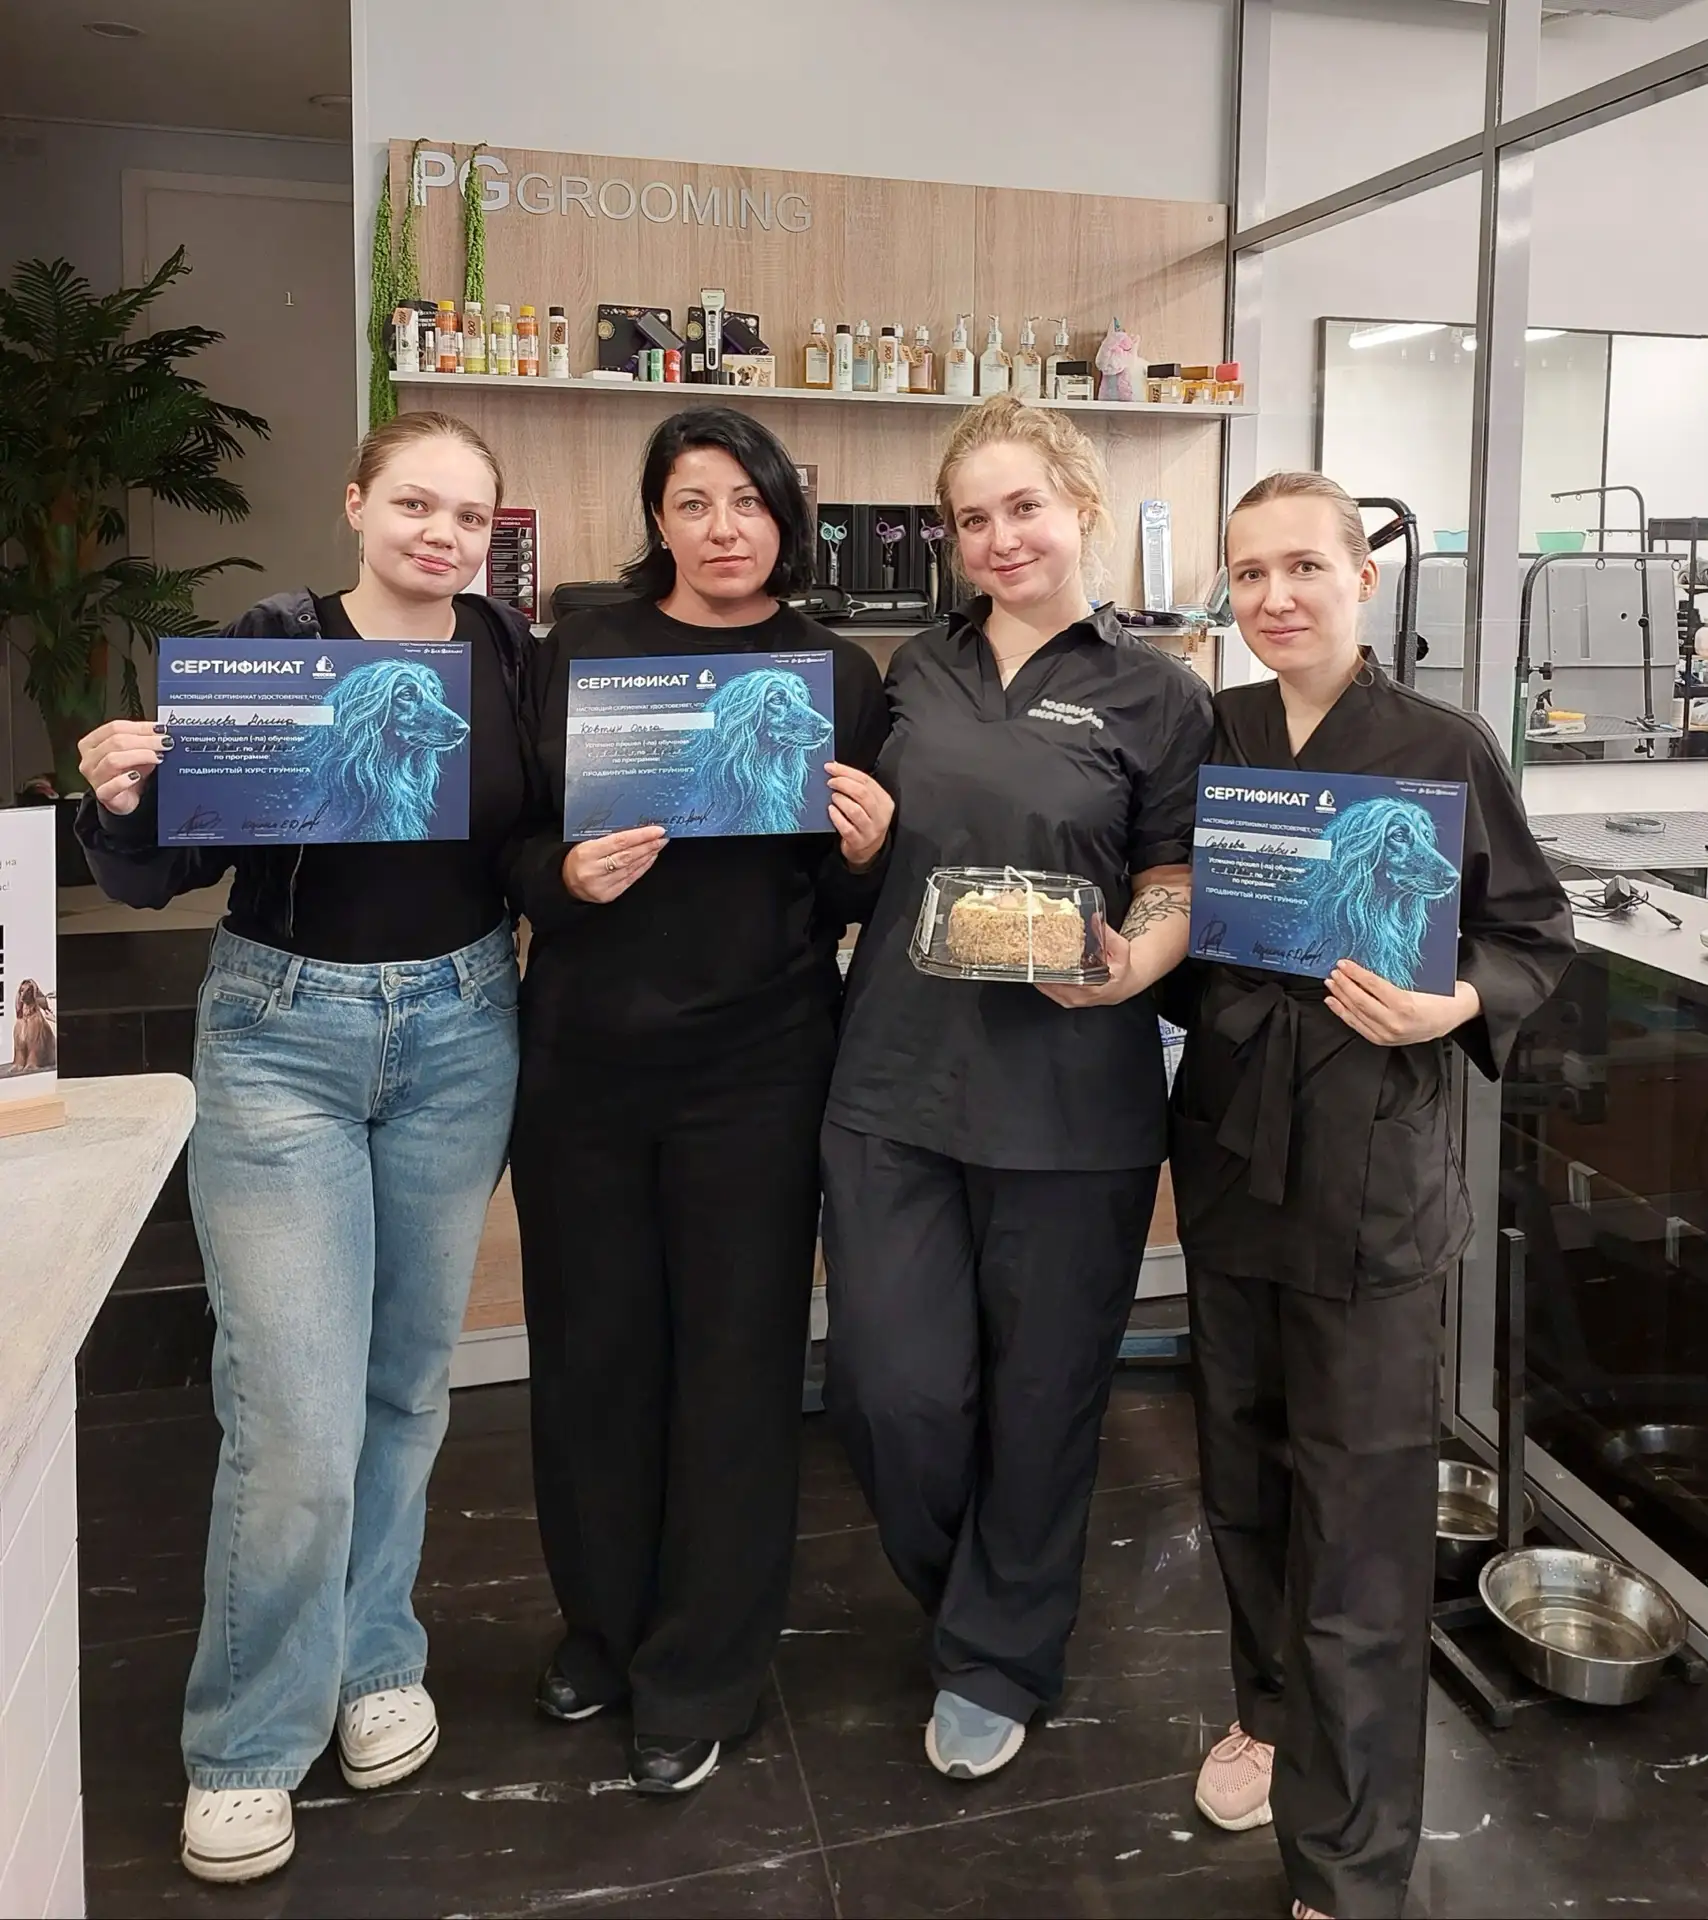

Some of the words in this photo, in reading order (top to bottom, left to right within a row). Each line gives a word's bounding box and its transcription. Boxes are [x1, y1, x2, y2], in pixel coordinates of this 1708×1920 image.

[412, 150, 510, 212] PG
[516, 172, 813, 233] GROOMING
[285, 291, 294, 306] 1
[170, 660, 304, 674] СЕРТИФИКАТ
[577, 674, 690, 690] СЕРТИФИКАТ
[1204, 786, 1310, 806] СЕРТИФИКАТ
[1205, 887, 1254, 898] ПРОДВИНУТЫЙ
[1255, 893, 1272, 901] КУРС
[1274, 895, 1309, 906] ГРУМИНГА
